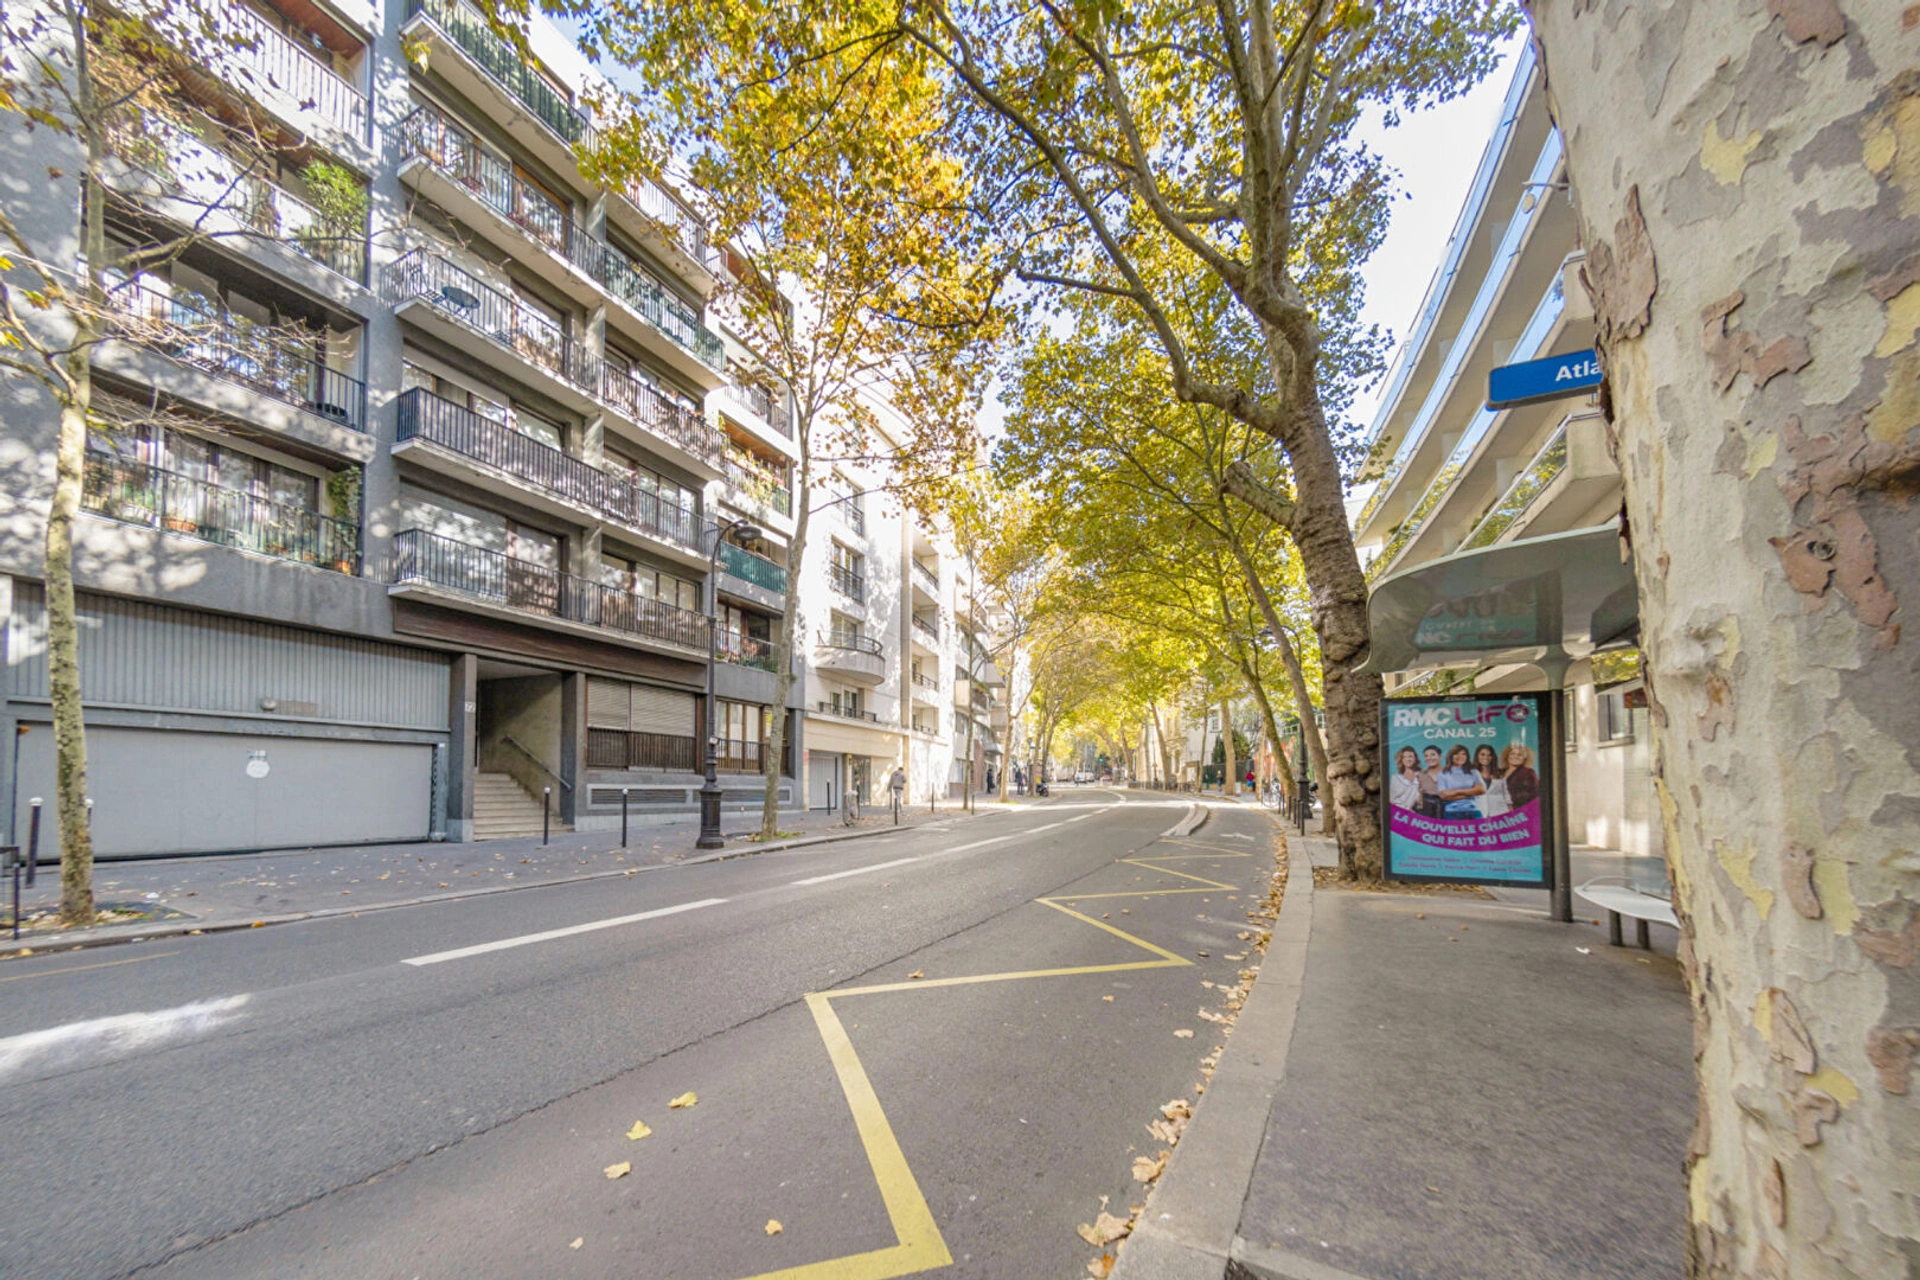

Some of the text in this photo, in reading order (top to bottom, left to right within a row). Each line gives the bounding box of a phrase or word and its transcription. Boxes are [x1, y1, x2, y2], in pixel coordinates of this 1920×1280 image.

[1393, 707, 1451, 727] RMC
[1423, 727, 1497, 739] CANAL 25
[1393, 811, 1409, 824] LA
[1411, 817, 1476, 834] NOUVELLE
[1422, 829, 1530, 846] QUI FAIT DU BIEN
